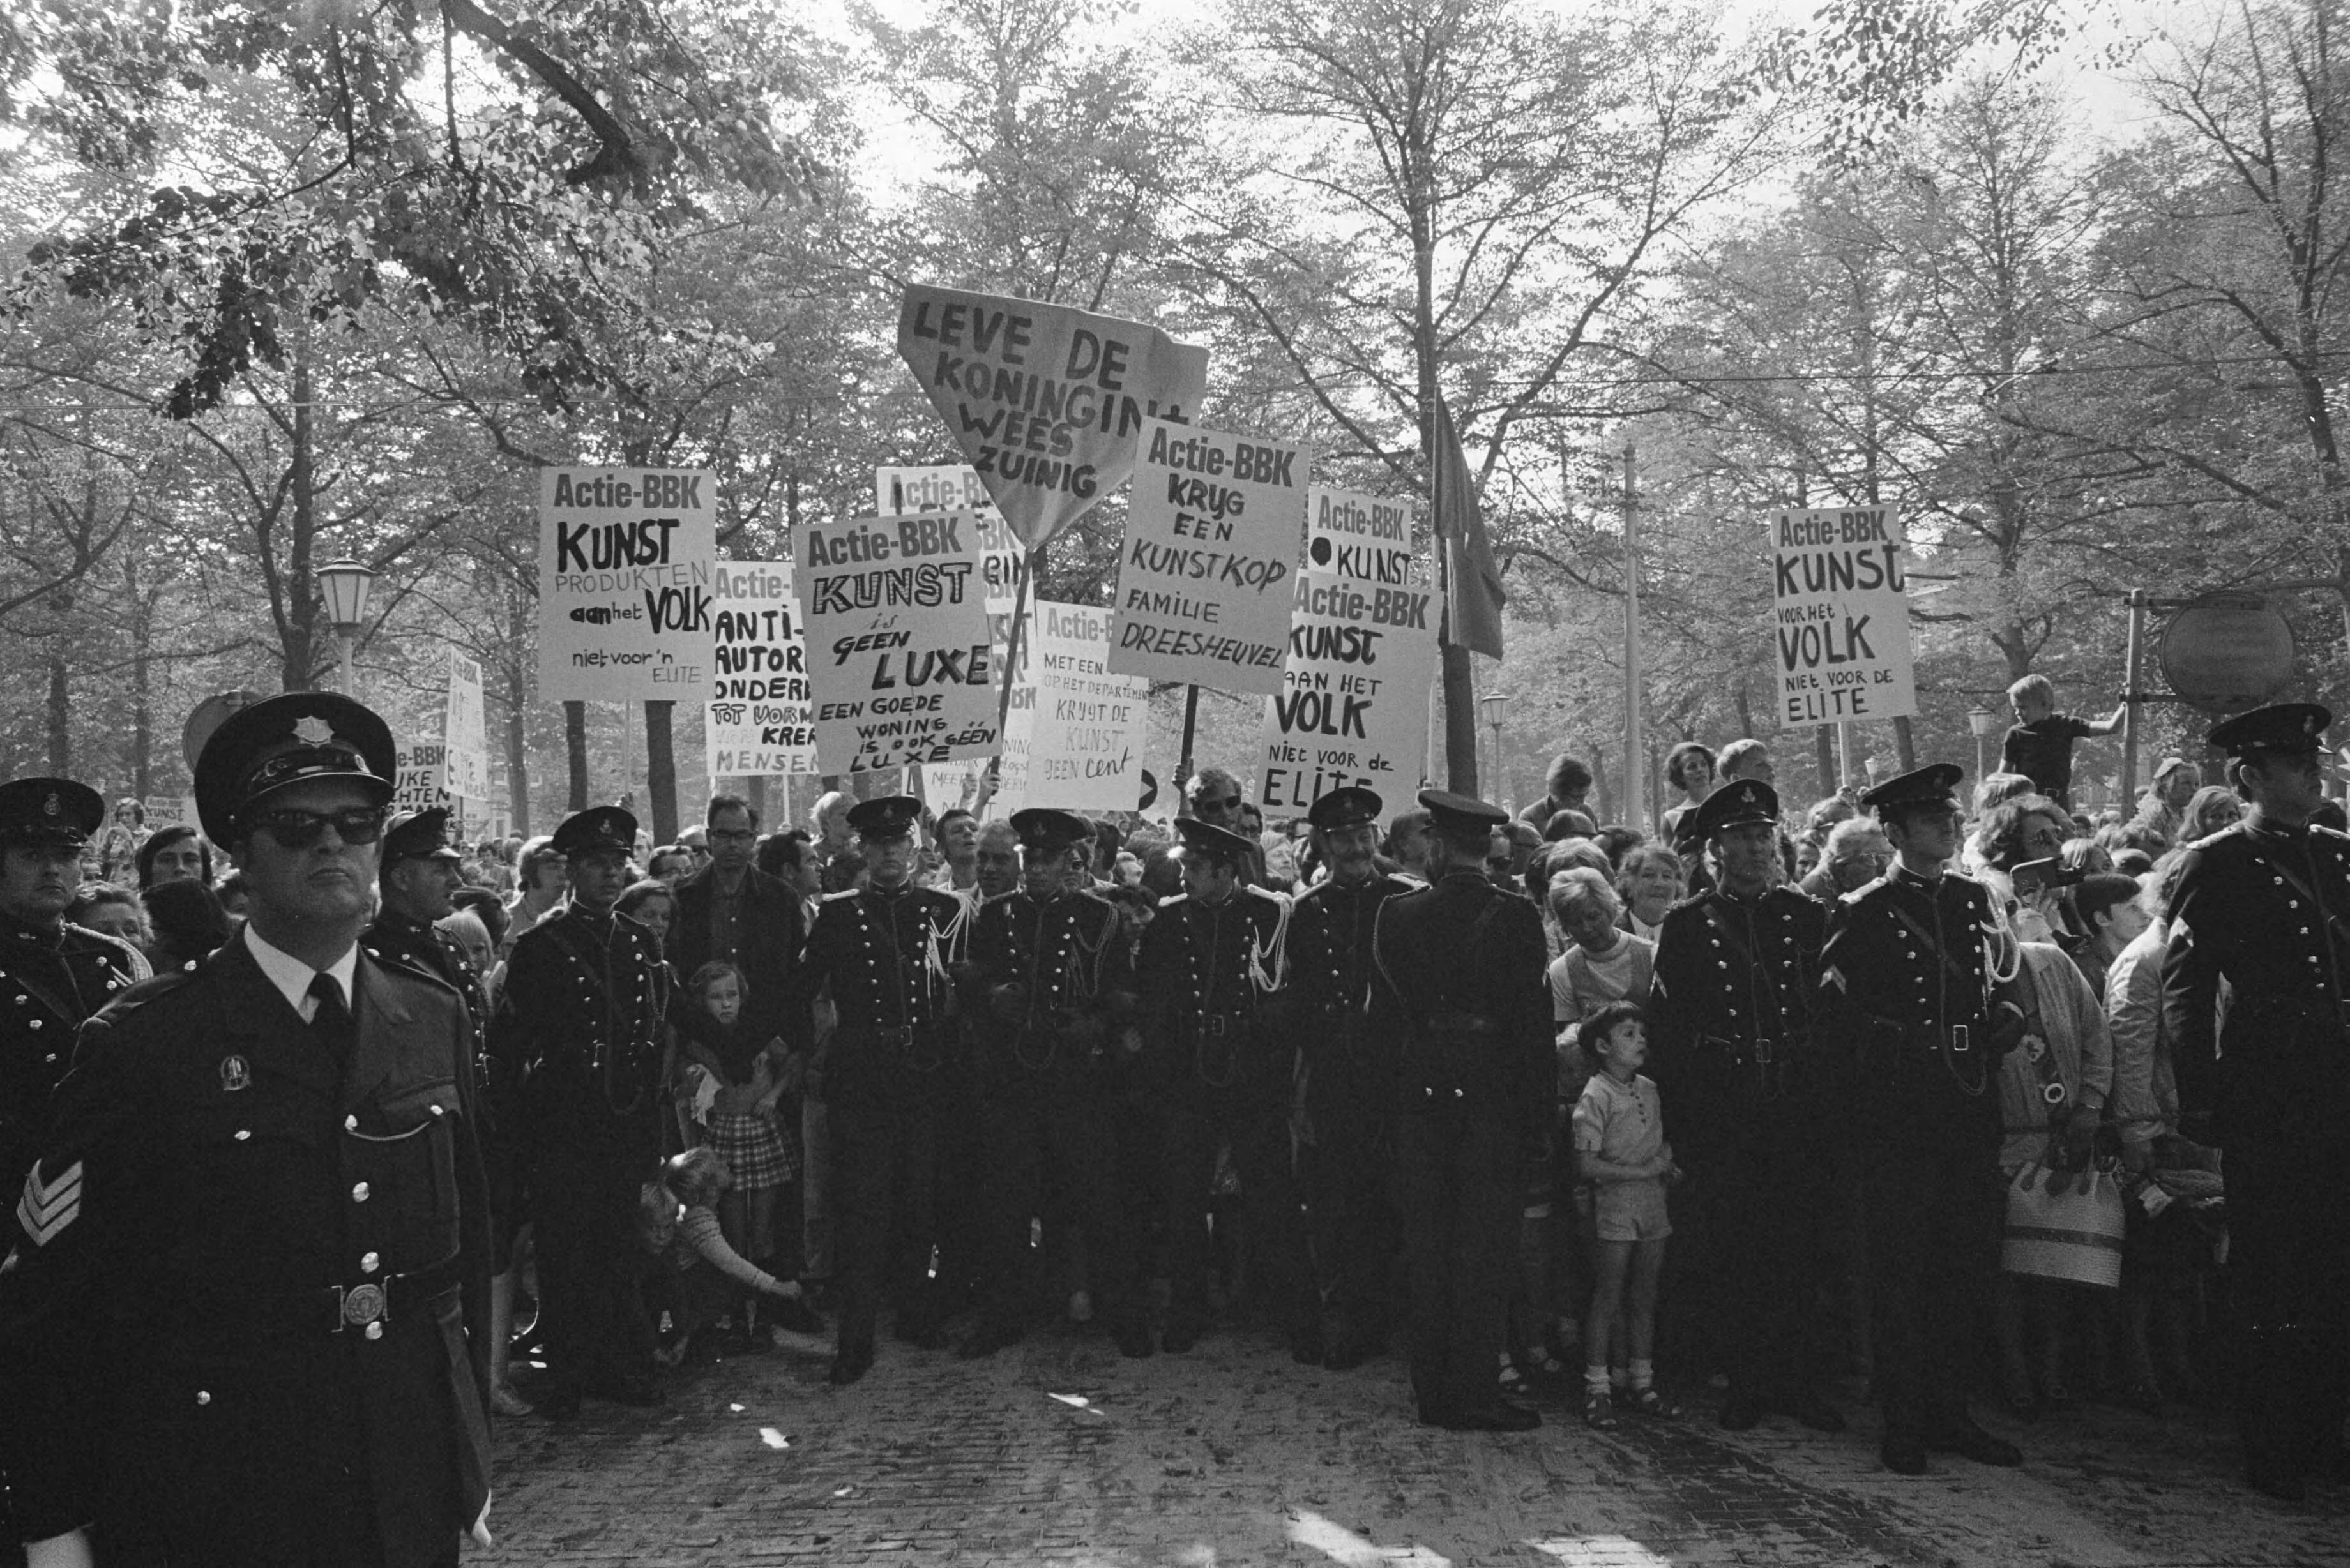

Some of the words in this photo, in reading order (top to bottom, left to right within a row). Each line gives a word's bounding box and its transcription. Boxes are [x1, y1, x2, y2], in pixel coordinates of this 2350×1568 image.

[913, 301, 1033, 365] LEVE
[1065, 328, 1130, 391] DE
[934, 351, 1158, 438] KONINGIN
[959, 402, 1073, 458] WEES
[975, 445, 1097, 499] ZUINIG
[1148, 427, 1296, 487] Actie-BBK
[554, 473, 701, 509] Actie-BBK
[1174, 513, 1233, 541] EEN
[1317, 495, 1404, 541] Actie-BBK
[1780, 511, 1888, 547] Actie-BBK
[557, 519, 679, 573] KUNST
[809, 516, 962, 567] Actie-BBK
[556, 561, 709, 593] PRODUKTEN
[1338, 543, 1411, 585] KUNST
[716, 567, 798, 599] Actie-
[812, 562, 973, 614] KUNST
[612, 602, 642, 620] het
[643, 585, 712, 634] VOLK
[1292, 577, 1430, 629] Actie-BBK
[1778, 607, 1805, 624] VOOR
[573, 648, 607, 668] niet
[610, 652, 652, 665] voor
[833, 631, 911, 665] GEEN
[1121, 622, 1284, 668] DREESHEUVEL
[1778, 614, 1876, 671] VOLK
[716, 645, 808, 675] AUTOR
[872, 645, 989, 690] LUXE
[1045, 652, 1075, 670] MET
[1079, 660, 1103, 675] EEN
[1044, 674, 1061, 688] OP
[1063, 677, 1086, 692] HET
[1285, 670, 1328, 691] AAN
[1340, 674, 1383, 696] HET
[1827, 670, 1867, 686] VOOR
[1874, 670, 1894, 684] DE
[711, 703, 747, 725] TOT
[819, 702, 863, 721] EEN
[870, 694, 944, 716] GOEDE
[1112, 705, 1131, 722] DE
[1275, 690, 1373, 739] VOLK
[856, 718, 947, 739] WONING
[1066, 726, 1124, 752] KUNST
[850, 745, 950, 772] LUXE
[1317, 749, 1358, 768] VOOR
[392, 787, 450, 803] HTEN
